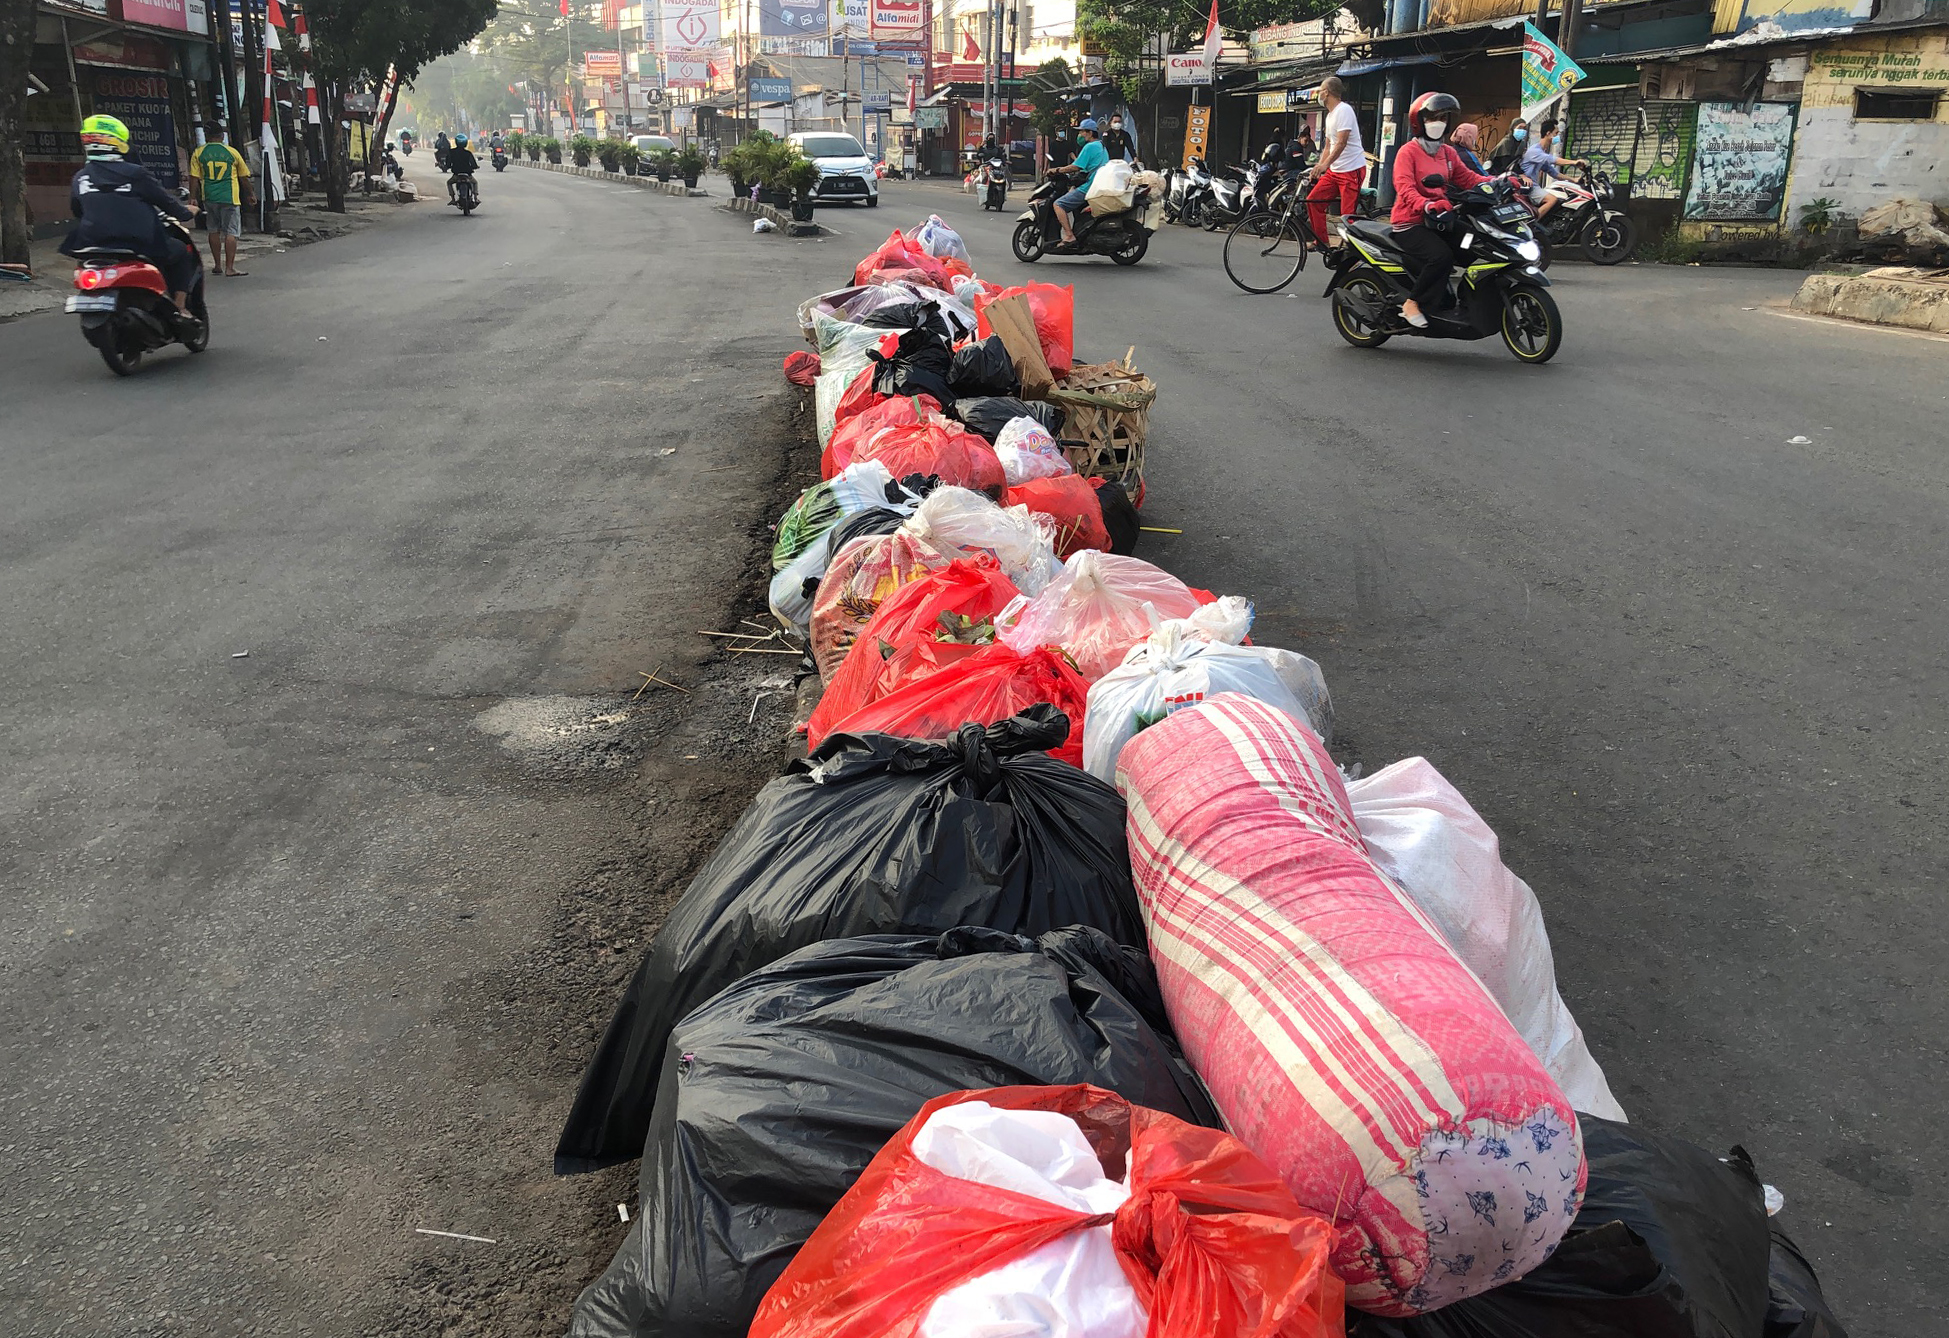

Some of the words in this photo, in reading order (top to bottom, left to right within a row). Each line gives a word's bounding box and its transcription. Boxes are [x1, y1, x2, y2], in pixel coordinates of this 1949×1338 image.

[876, 12, 919, 24] Alfamidi
[1257, 27, 1287, 42] KUBANG
[1171, 57, 1205, 68] Cano
[1814, 52, 1879, 68] Semuanya
[1882, 54, 1921, 67] Murah
[1829, 68, 1879, 81] serunya
[1881, 69, 1918, 82] nggak
[99, 77, 169, 99] GROSIR
[761, 84, 791, 96] vespa
[104, 101, 136, 113] PAKET
[138, 103, 171, 115] KUOTA
[207, 160, 227, 180] 17
